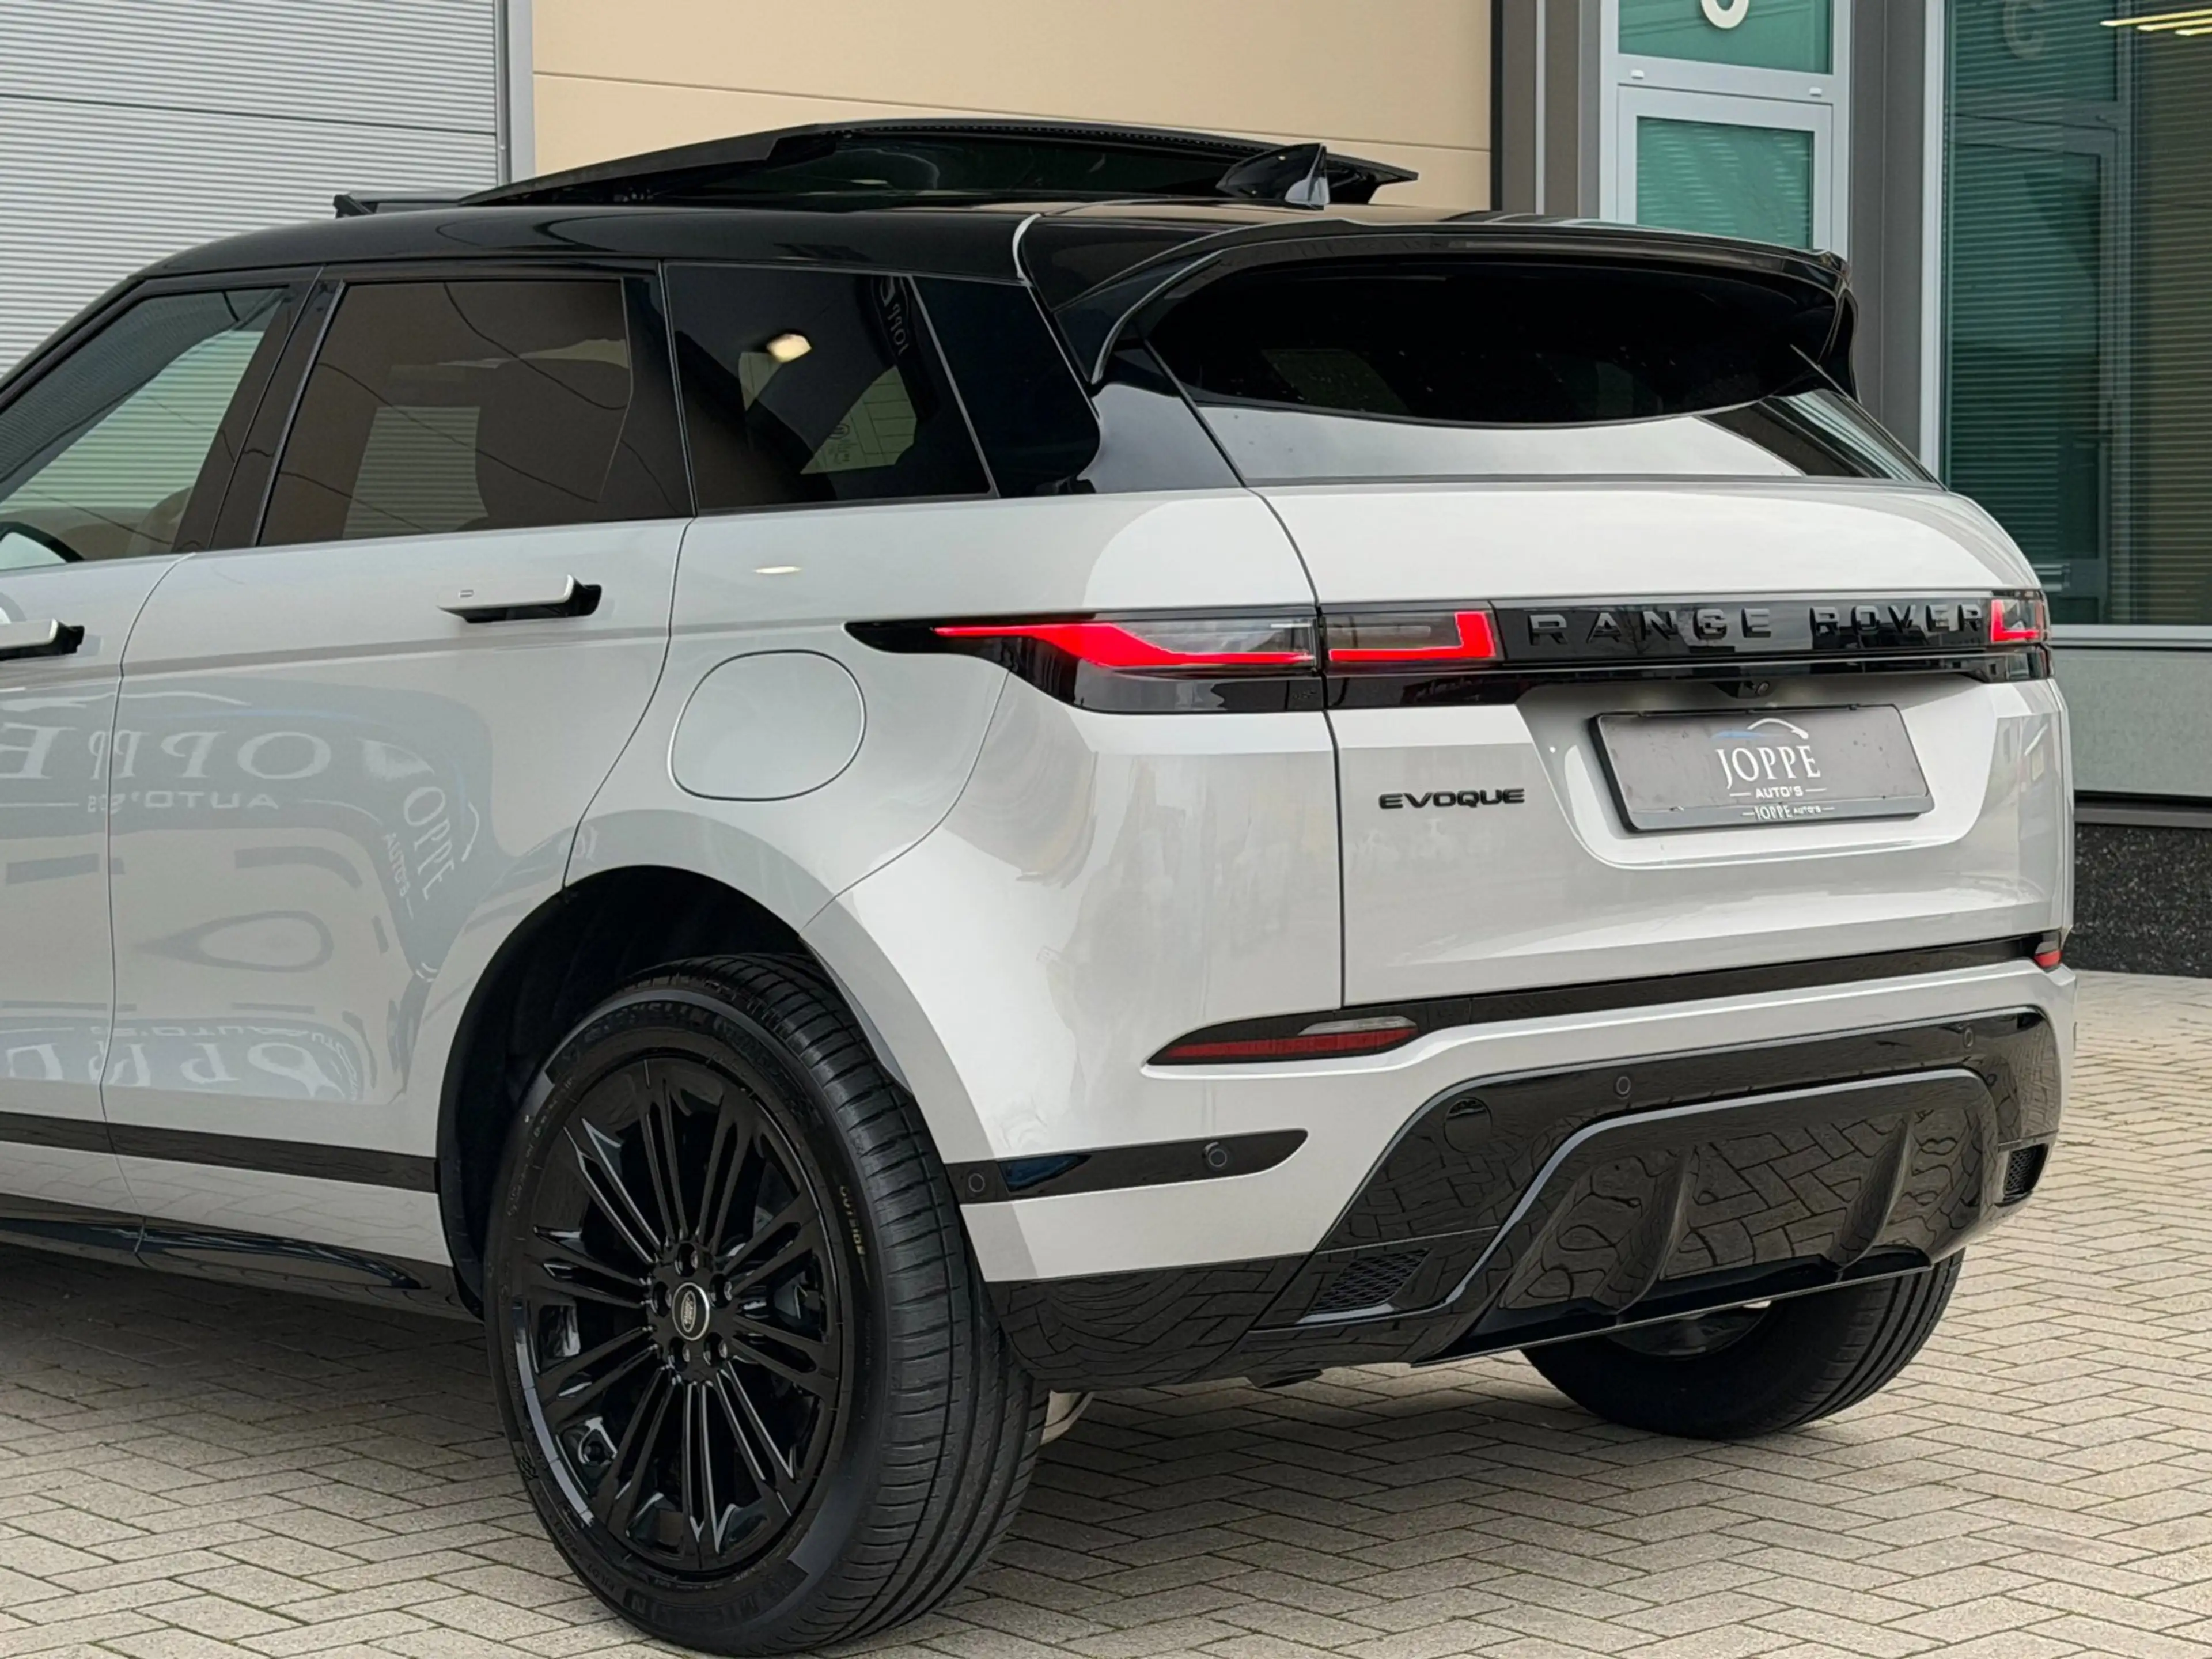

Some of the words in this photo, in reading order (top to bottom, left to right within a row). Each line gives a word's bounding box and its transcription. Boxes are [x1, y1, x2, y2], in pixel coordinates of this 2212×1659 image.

[1528, 608, 1772, 645] RANGE
[1809, 604, 1983, 635] ROVER
[1715, 745, 1821, 789] JOPPE
[1378, 787, 1525, 809] EVOQUE
[1756, 785, 1804, 799] AUTO'S
[1754, 802, 1793, 821] JOPPE
